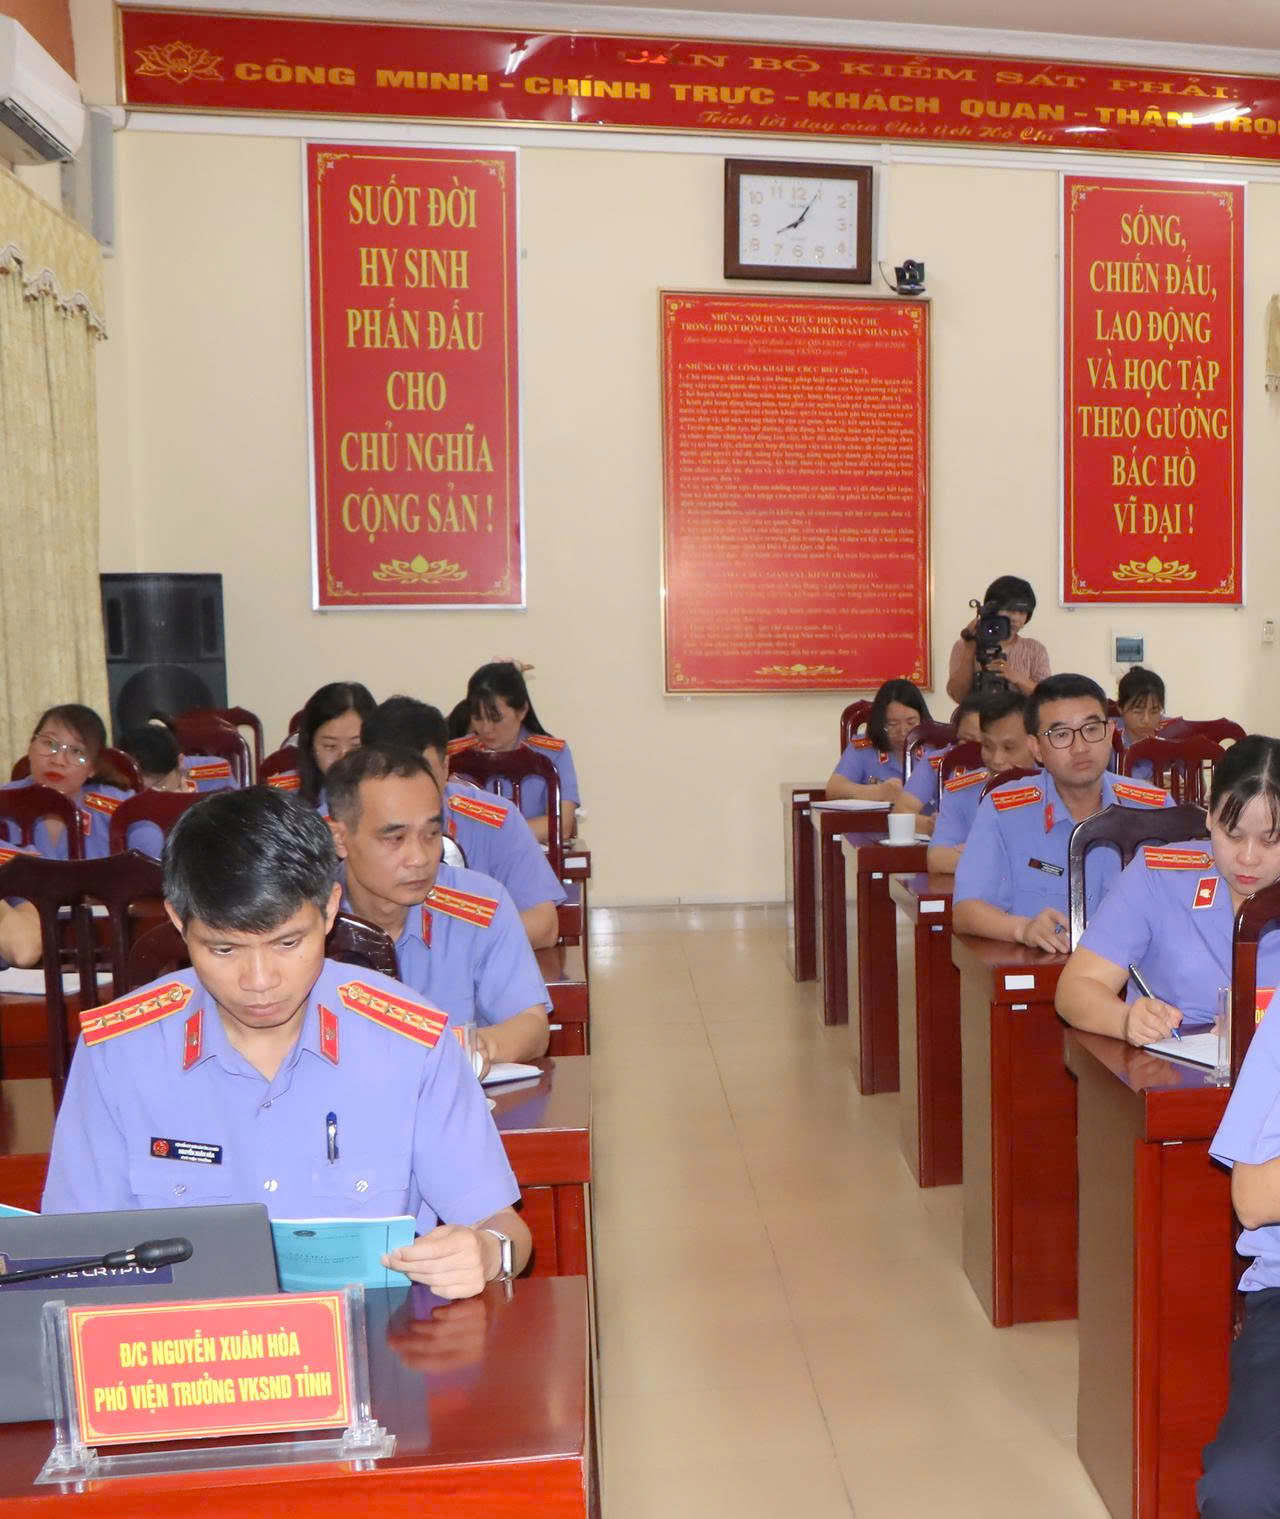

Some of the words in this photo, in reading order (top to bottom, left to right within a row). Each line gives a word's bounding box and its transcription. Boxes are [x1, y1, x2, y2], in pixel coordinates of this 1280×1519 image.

[749, 52, 820, 79] BỘ
[840, 54, 977, 82] KIỂM
[996, 64, 1085, 89] SÁT
[235, 58, 356, 86] CÔNG
[376, 69, 489, 92] MINH
[524, 74, 651, 100] CHÍNH
[669, 82, 775, 109] TRỰC
[807, 87, 940, 114] KHÁCH
[961, 98, 1065, 122] QUAN
[1099, 105, 1193, 134] THẬN
[349, 173, 420, 226] SUỐT
[427, 175, 478, 228] ĐỜI
[1120, 204, 1187, 251] SỐNG,
[359, 247, 399, 287] HY
[405, 248, 470, 289] SINH
[1090, 252, 1159, 294] CHIẾN
[1166, 254, 1217, 302] ĐẤU,
[346, 297, 420, 349] PHẤN
[427, 298, 485, 351] ĐẤU
[1096, 309, 1142, 342] LAO
[1147, 306, 1211, 351] ĐỘNG
[386, 371, 447, 411] CHO
[1087, 348, 1118, 390] VÀ
[1124, 358, 1172, 399] HỌC
[1178, 355, 1220, 399] TẬP
[1078, 406, 1141, 438] THEO
[1146, 402, 1228, 440] GƯƠNG
[340, 420, 399, 472] CHỦ
[406, 423, 494, 473] NGHĨA
[1112, 445, 1157, 486] BÁC
[1163, 446, 1196, 487] HỒ
[342, 487, 420, 544] CỘNG
[428, 482, 478, 533] SẢN
[1114, 495, 1137, 534] VĨ
[1143, 503, 1182, 543] ĐẠI
[119, 1342, 148, 1369] Đ/C
[152, 1328, 216, 1365] NGUYỄN
[220, 1329, 264, 1361] XUÂN
[267, 1326, 301, 1357] HÒA
[94, 1380, 127, 1413] PHÓ
[131, 1379, 169, 1415] VIỆN
[172, 1371, 236, 1407] TRƯỞNG
[239, 1373, 292, 1402] VKSND
[295, 1364, 332, 1398] TỈNH
